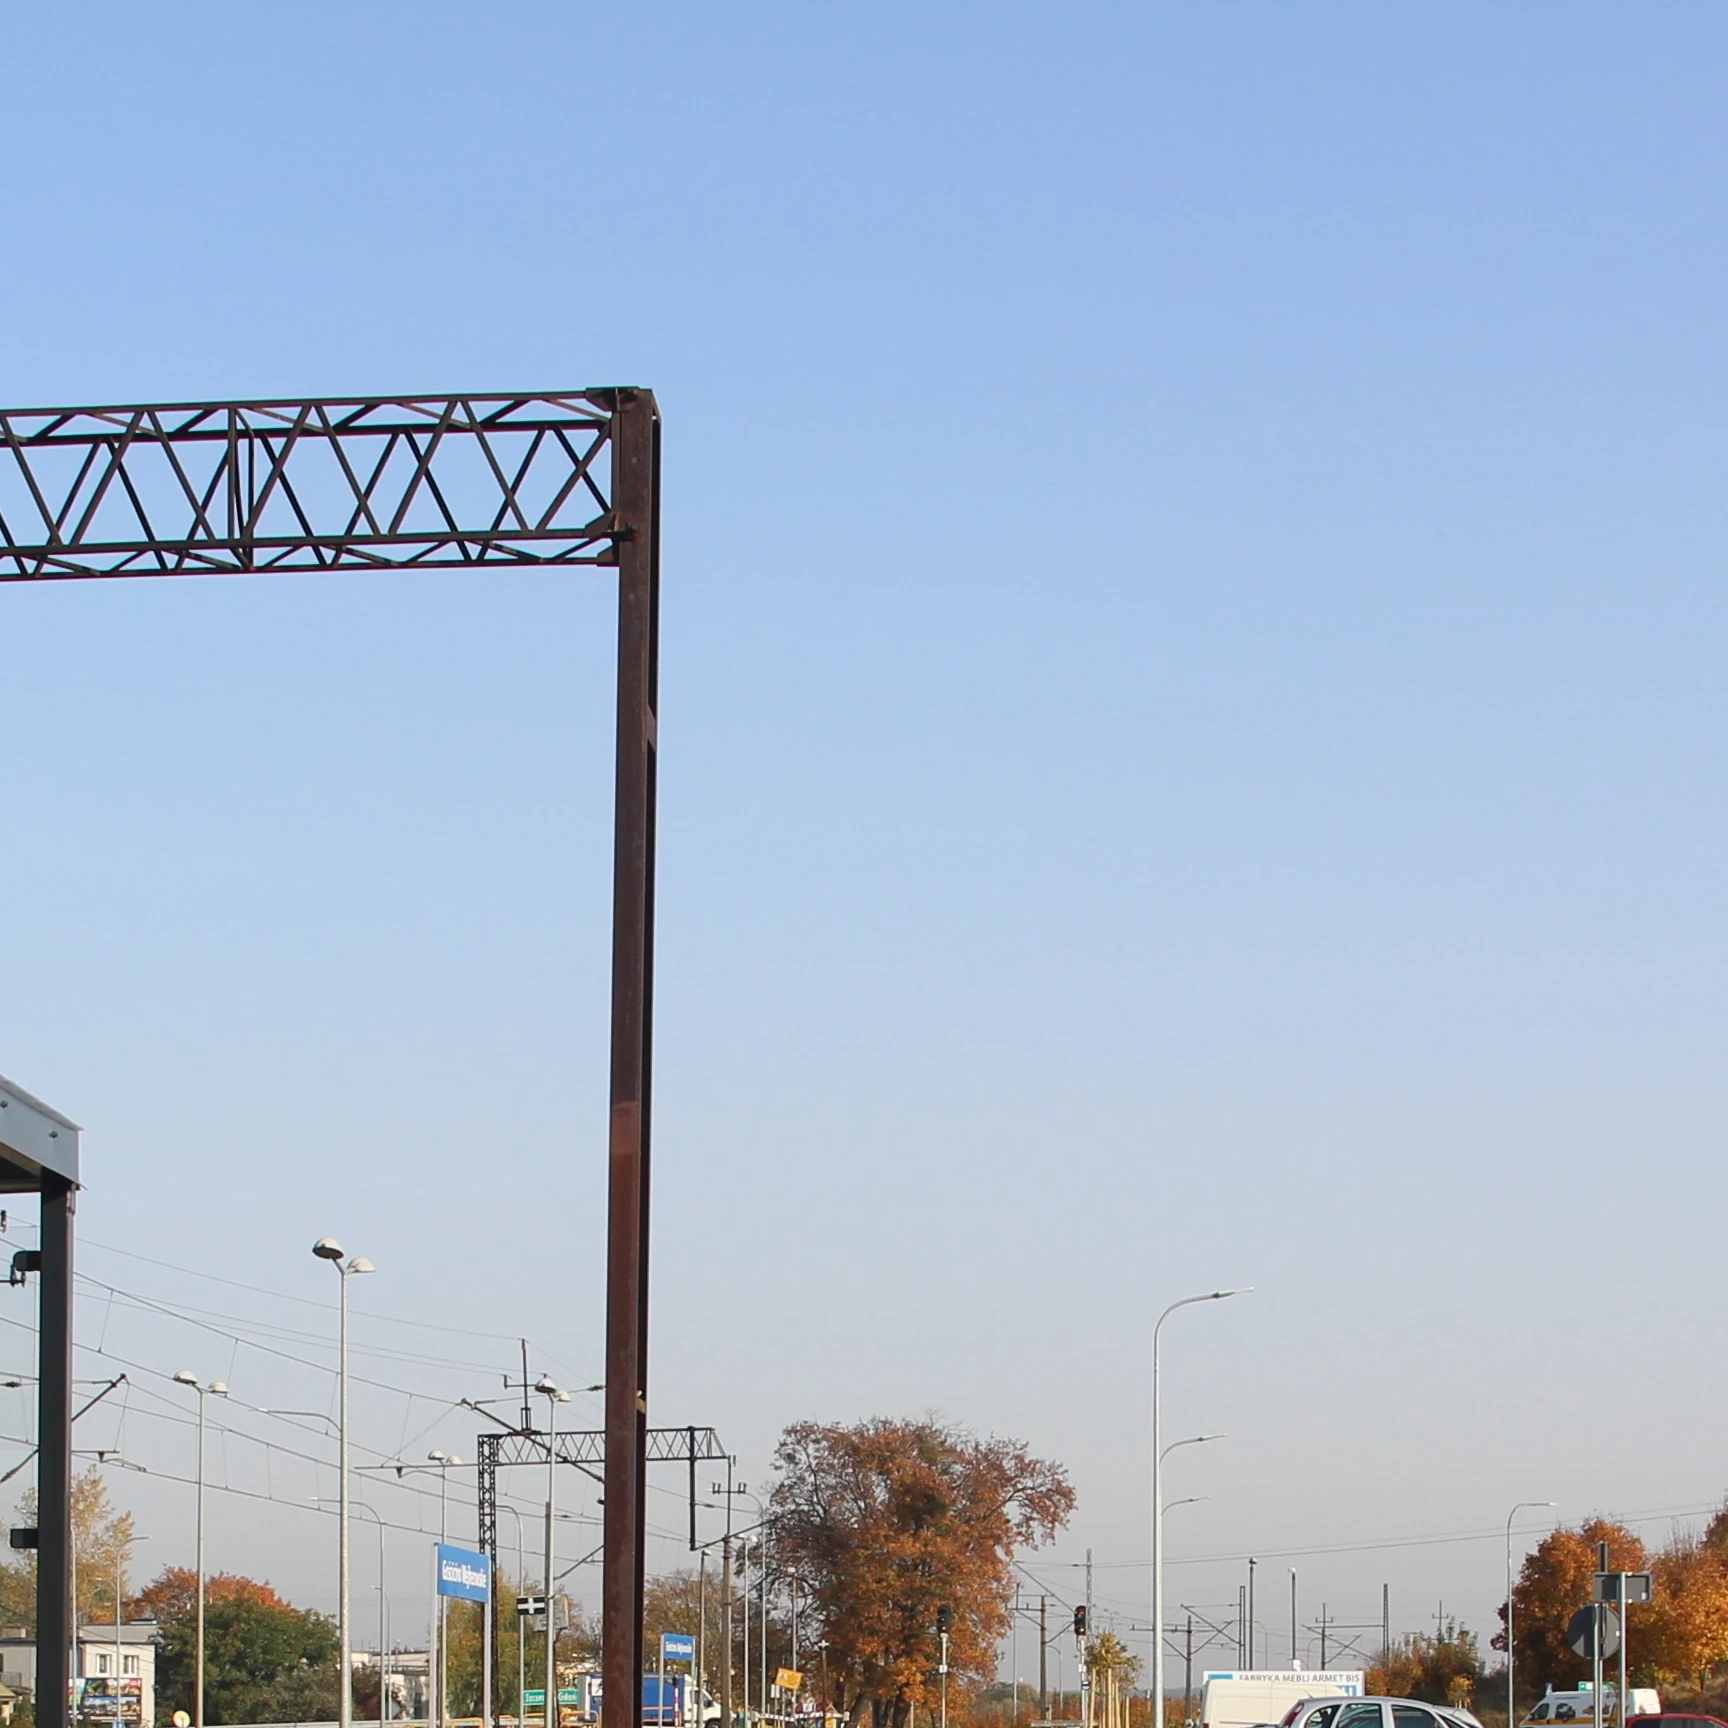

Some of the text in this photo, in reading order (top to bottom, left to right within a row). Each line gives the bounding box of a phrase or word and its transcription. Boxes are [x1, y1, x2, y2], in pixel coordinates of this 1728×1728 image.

[1282, 1674, 1310, 1683] MEBLI
[1312, 1674, 1343, 1683] ARMET
[1345, 1674, 1360, 1683] BIS
